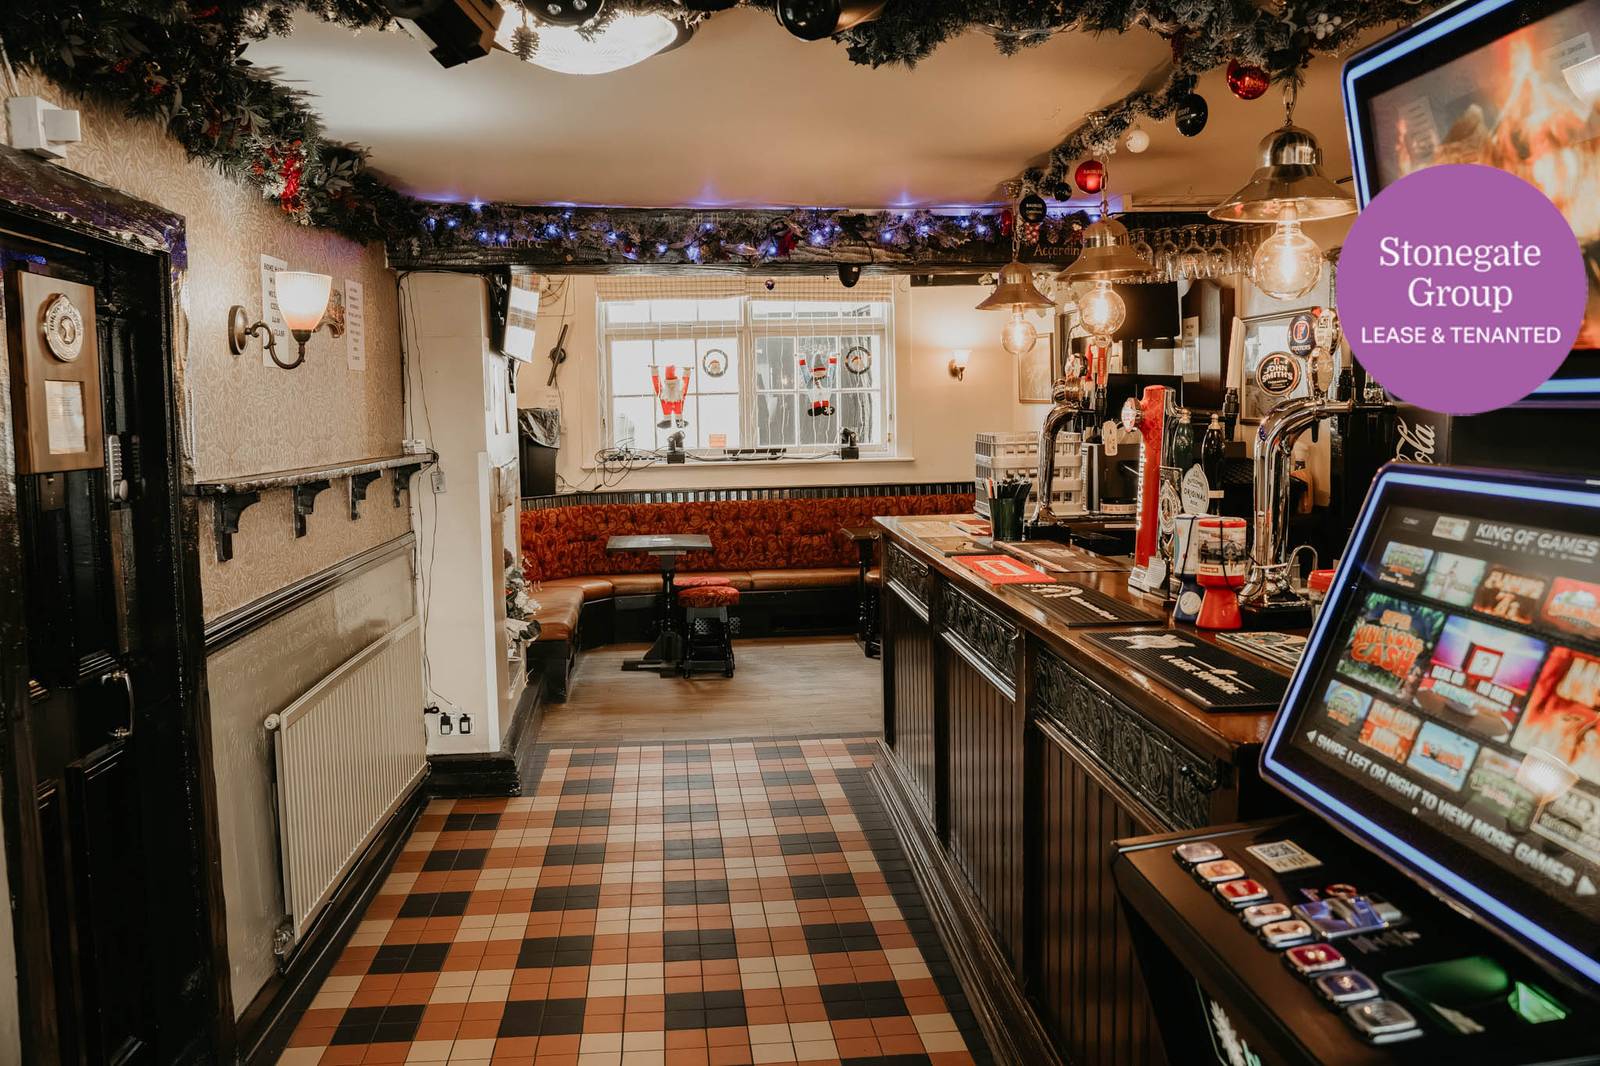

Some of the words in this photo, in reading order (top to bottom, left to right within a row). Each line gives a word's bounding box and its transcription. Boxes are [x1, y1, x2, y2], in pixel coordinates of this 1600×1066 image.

[1033, 243, 1080, 257] Accordin
[1264, 364, 1288, 375] JOHN
[1476, 522, 1513, 542] KING
[1514, 528, 1539, 546] OF
[1537, 534, 1600, 557] GAMES
[1352, 642, 1418, 679] CASH
[1316, 733, 1348, 760] SWIPE
[1346, 749, 1370, 772] LEFT
[1370, 764, 1387, 779] OR
[1385, 769, 1420, 801] RIGHT
[1420, 791, 1438, 812] TO
[1437, 798, 1474, 832] VIEW
[1471, 818, 1517, 855] MORE
[1514, 841, 1575, 888] GAMES
